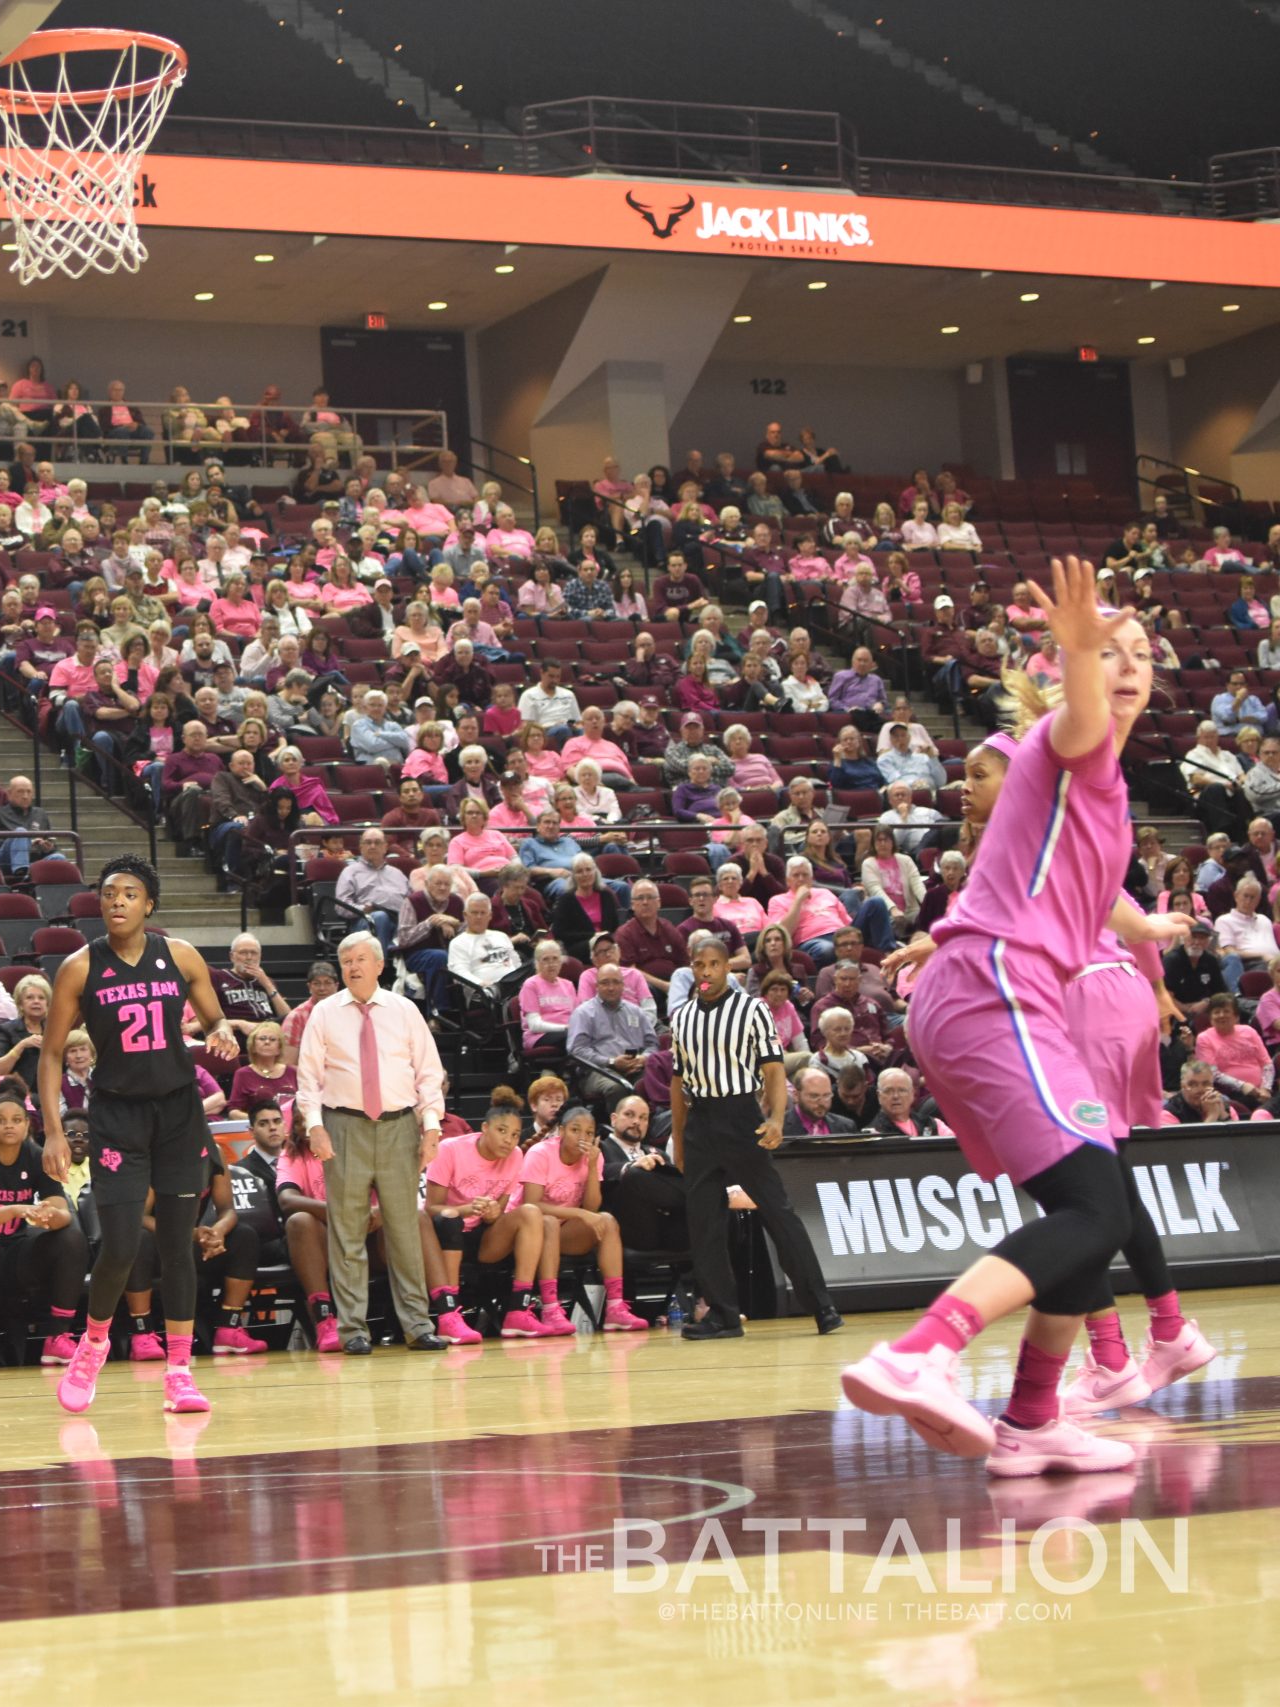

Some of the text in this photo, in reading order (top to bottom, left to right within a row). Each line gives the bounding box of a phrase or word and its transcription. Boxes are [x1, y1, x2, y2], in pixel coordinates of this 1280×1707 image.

[695, 201, 778, 242] JACK
[730, 241, 839, 256] PROTEIN SNACKS
[750, 378, 787, 396] 122
[96, 980, 180, 1006] TEXAS A&M
[118, 1000, 168, 1053] 21
[815, 1162, 1240, 1256] MUSCL ILK
